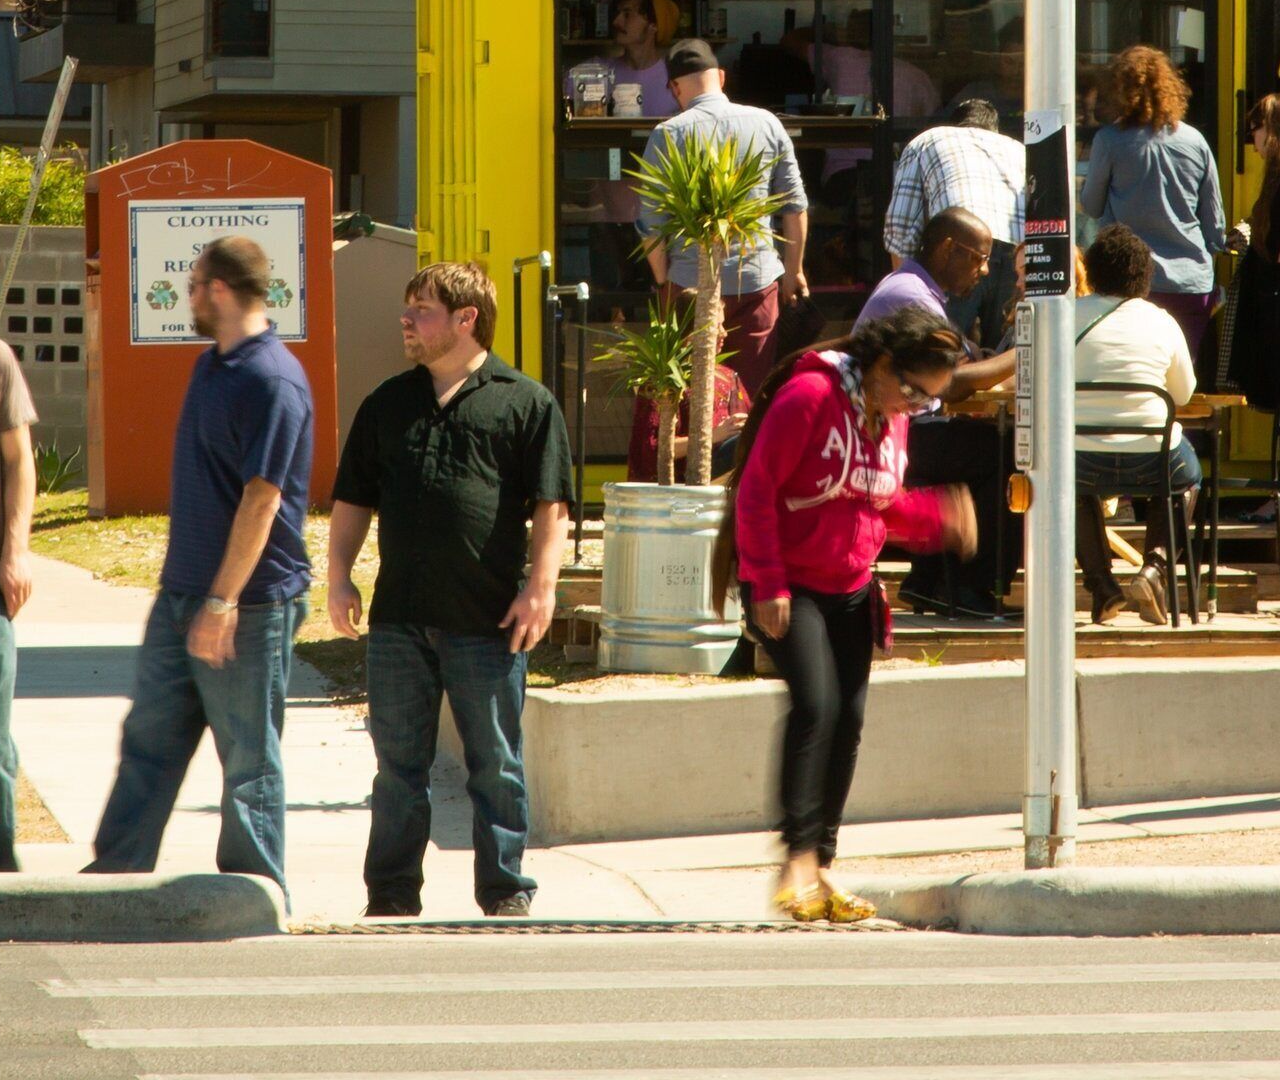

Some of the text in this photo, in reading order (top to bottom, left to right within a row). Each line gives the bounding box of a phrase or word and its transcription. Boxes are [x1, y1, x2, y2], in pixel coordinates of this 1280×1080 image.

[167, 214, 269, 228] CLOTHING
[1024, 219, 1067, 236] ERSON
[161, 323, 185, 332] FOR
